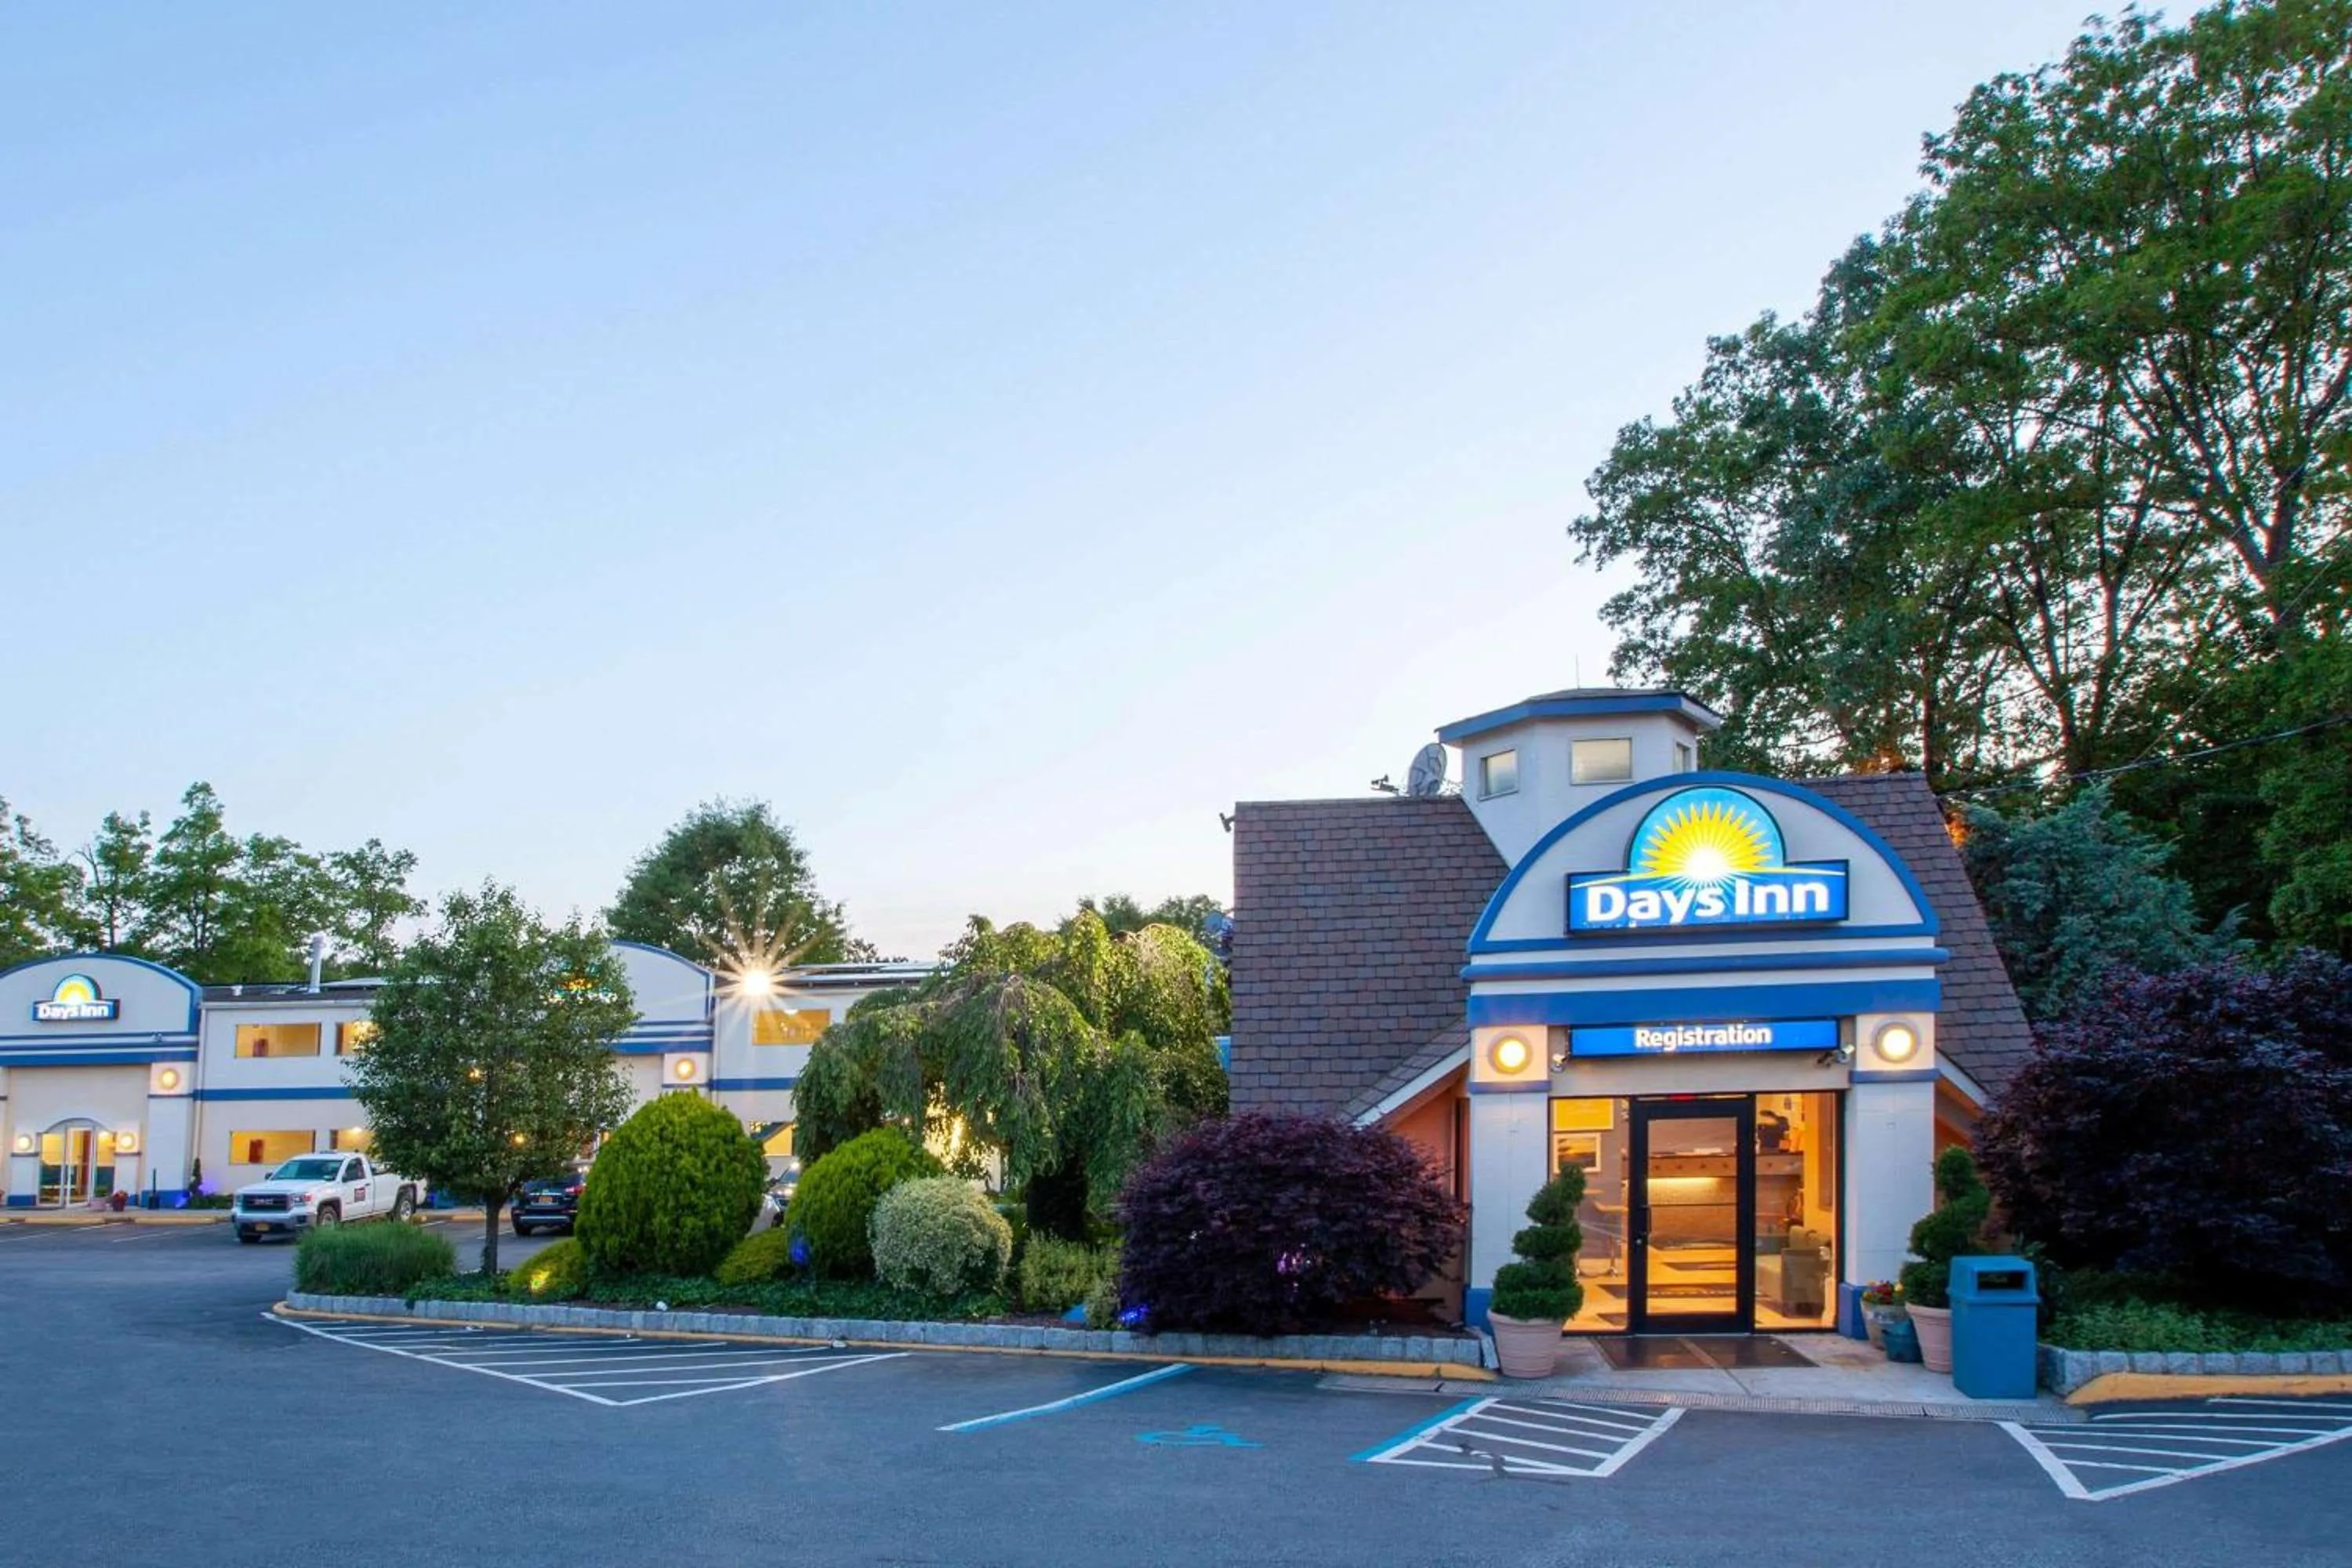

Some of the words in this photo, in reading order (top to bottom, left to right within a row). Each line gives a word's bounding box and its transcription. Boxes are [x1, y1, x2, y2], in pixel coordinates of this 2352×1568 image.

[1587, 885, 1724, 924] Days
[1735, 878, 1829, 916] Inn
[38, 1004, 78, 1019] Days
[80, 1004, 108, 1017] Inn
[1635, 1024, 1772, 1051] Registration
